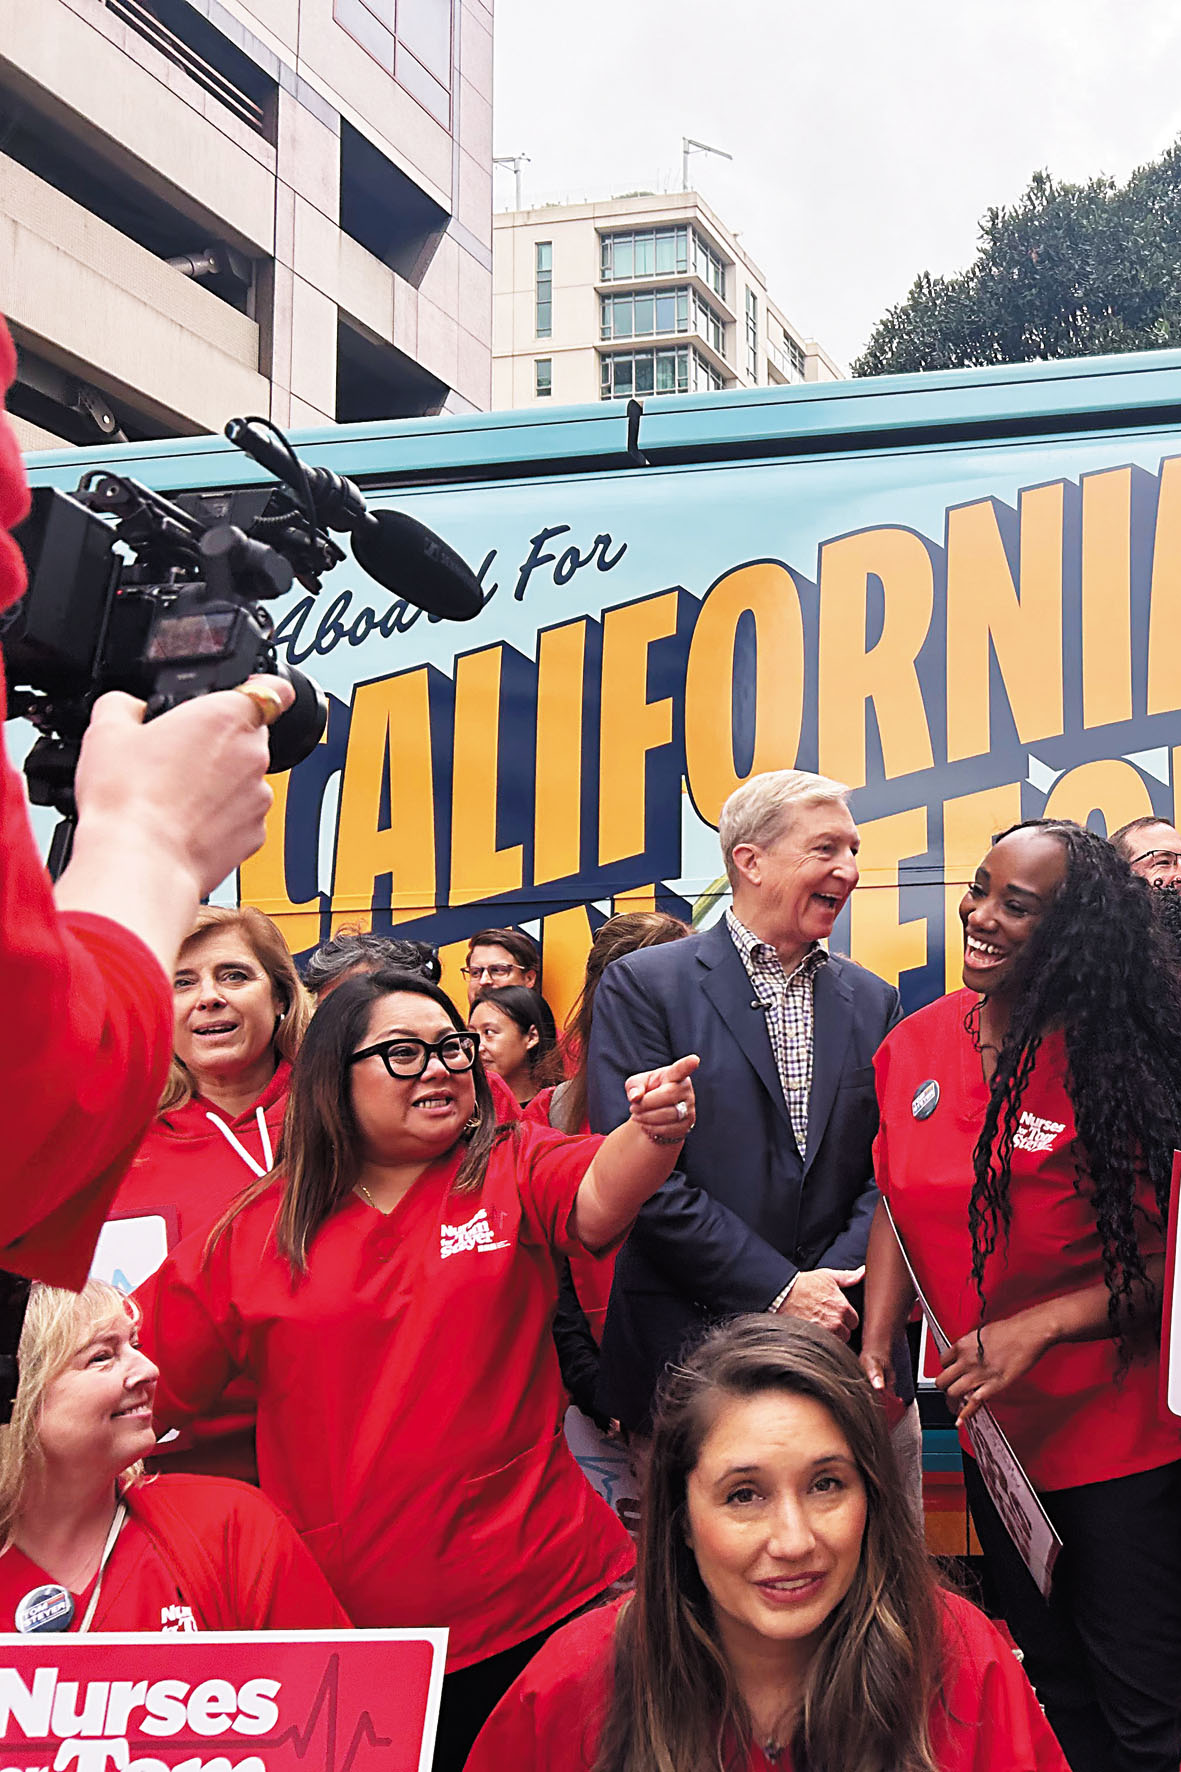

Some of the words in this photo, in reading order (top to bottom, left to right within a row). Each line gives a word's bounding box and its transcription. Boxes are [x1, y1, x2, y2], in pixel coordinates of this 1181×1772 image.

[274, 549, 498, 665] Aboa
[513, 525, 627, 601] For
[1019, 1111, 1067, 1133] Nurses
[1029, 1127, 1058, 1143] Tom
[0, 1667, 282, 1738] Nurses
